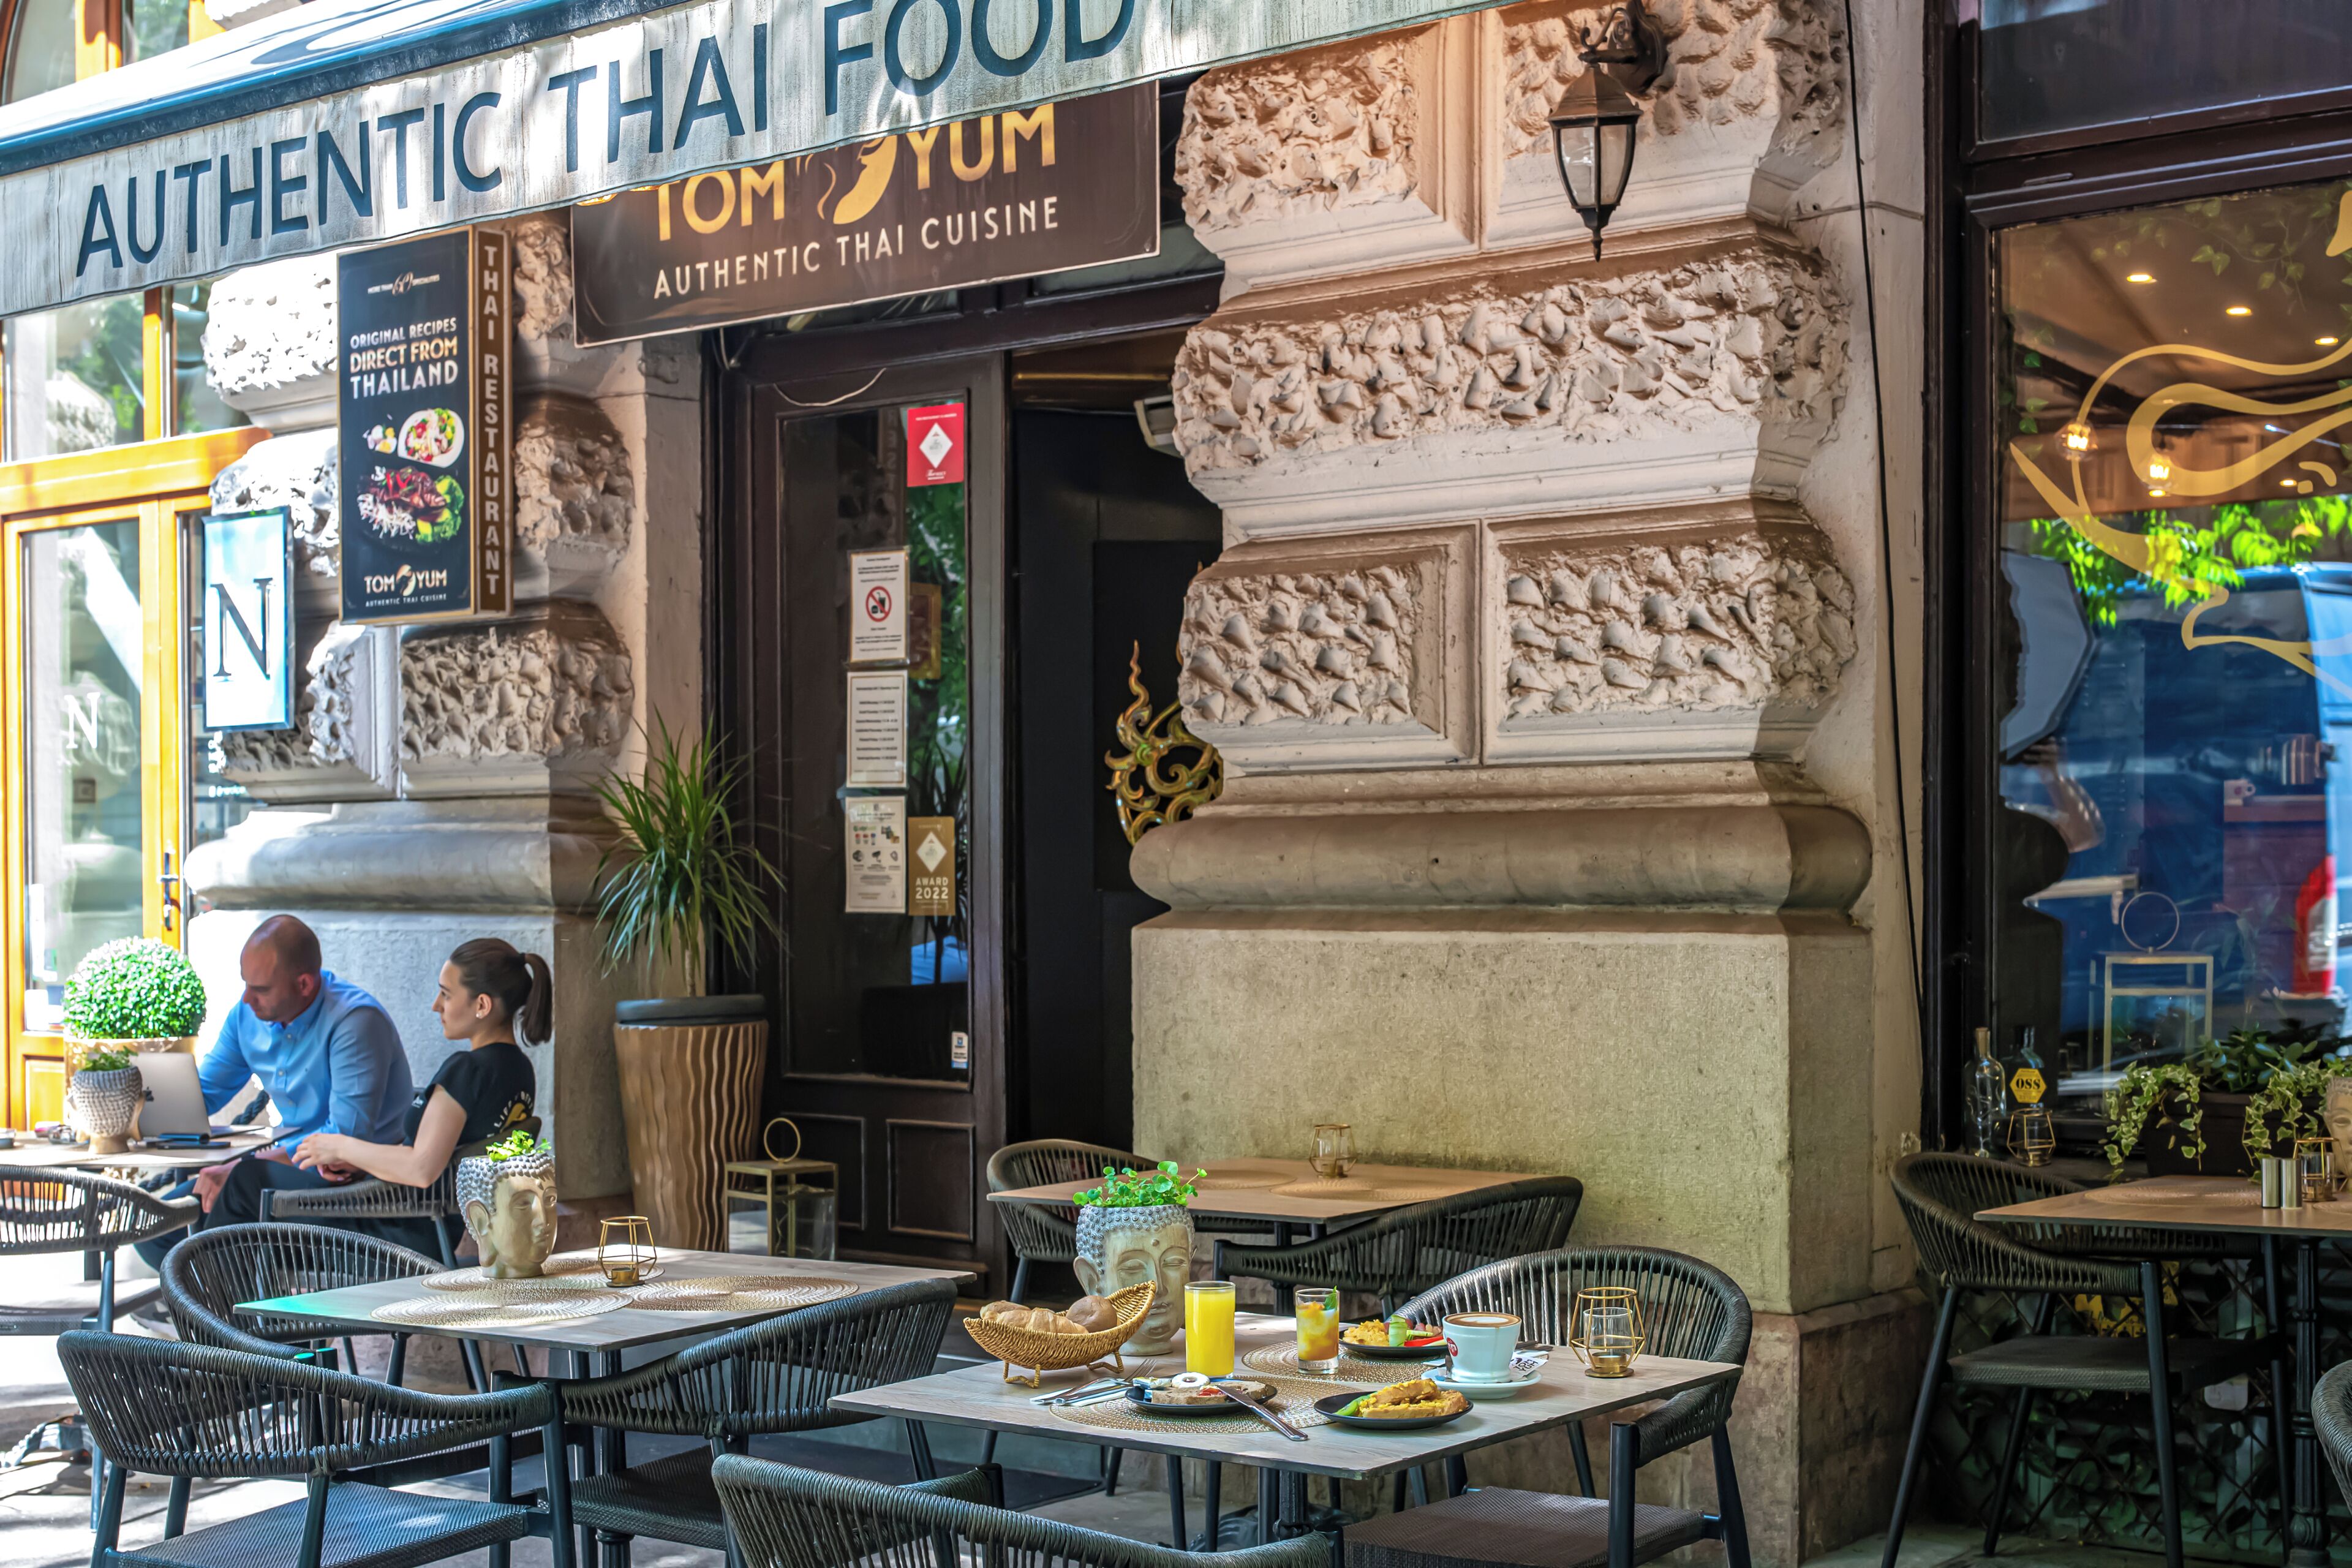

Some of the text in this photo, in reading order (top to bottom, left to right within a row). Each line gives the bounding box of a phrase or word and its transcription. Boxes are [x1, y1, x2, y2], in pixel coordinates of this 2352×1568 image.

[76, 0, 1134, 277] AUTHENTIC THAI FOOD
[657, 105, 1056, 242] TOM YUM
[654, 196, 1058, 299] AUTHENTIC THAI CUISINE
[350, 317, 456, 349] ORIGINAL RECIPES
[350, 336, 458, 373] DIRECT FROM
[350, 360, 458, 399] THAILAND
[483, 246, 500, 595] THAI RESTAURANT
[364, 569, 447, 594] TOM YUM
[210, 578, 273, 680] N
[64, 692, 101, 749] N
[915, 877, 949, 886] AWARD
[916, 887, 949, 899] 2022
[2016, 1078, 2040, 1089] OSS
[1513, 1359, 1532, 1369] TOM
[1518, 1361, 1539, 1372] YUM
